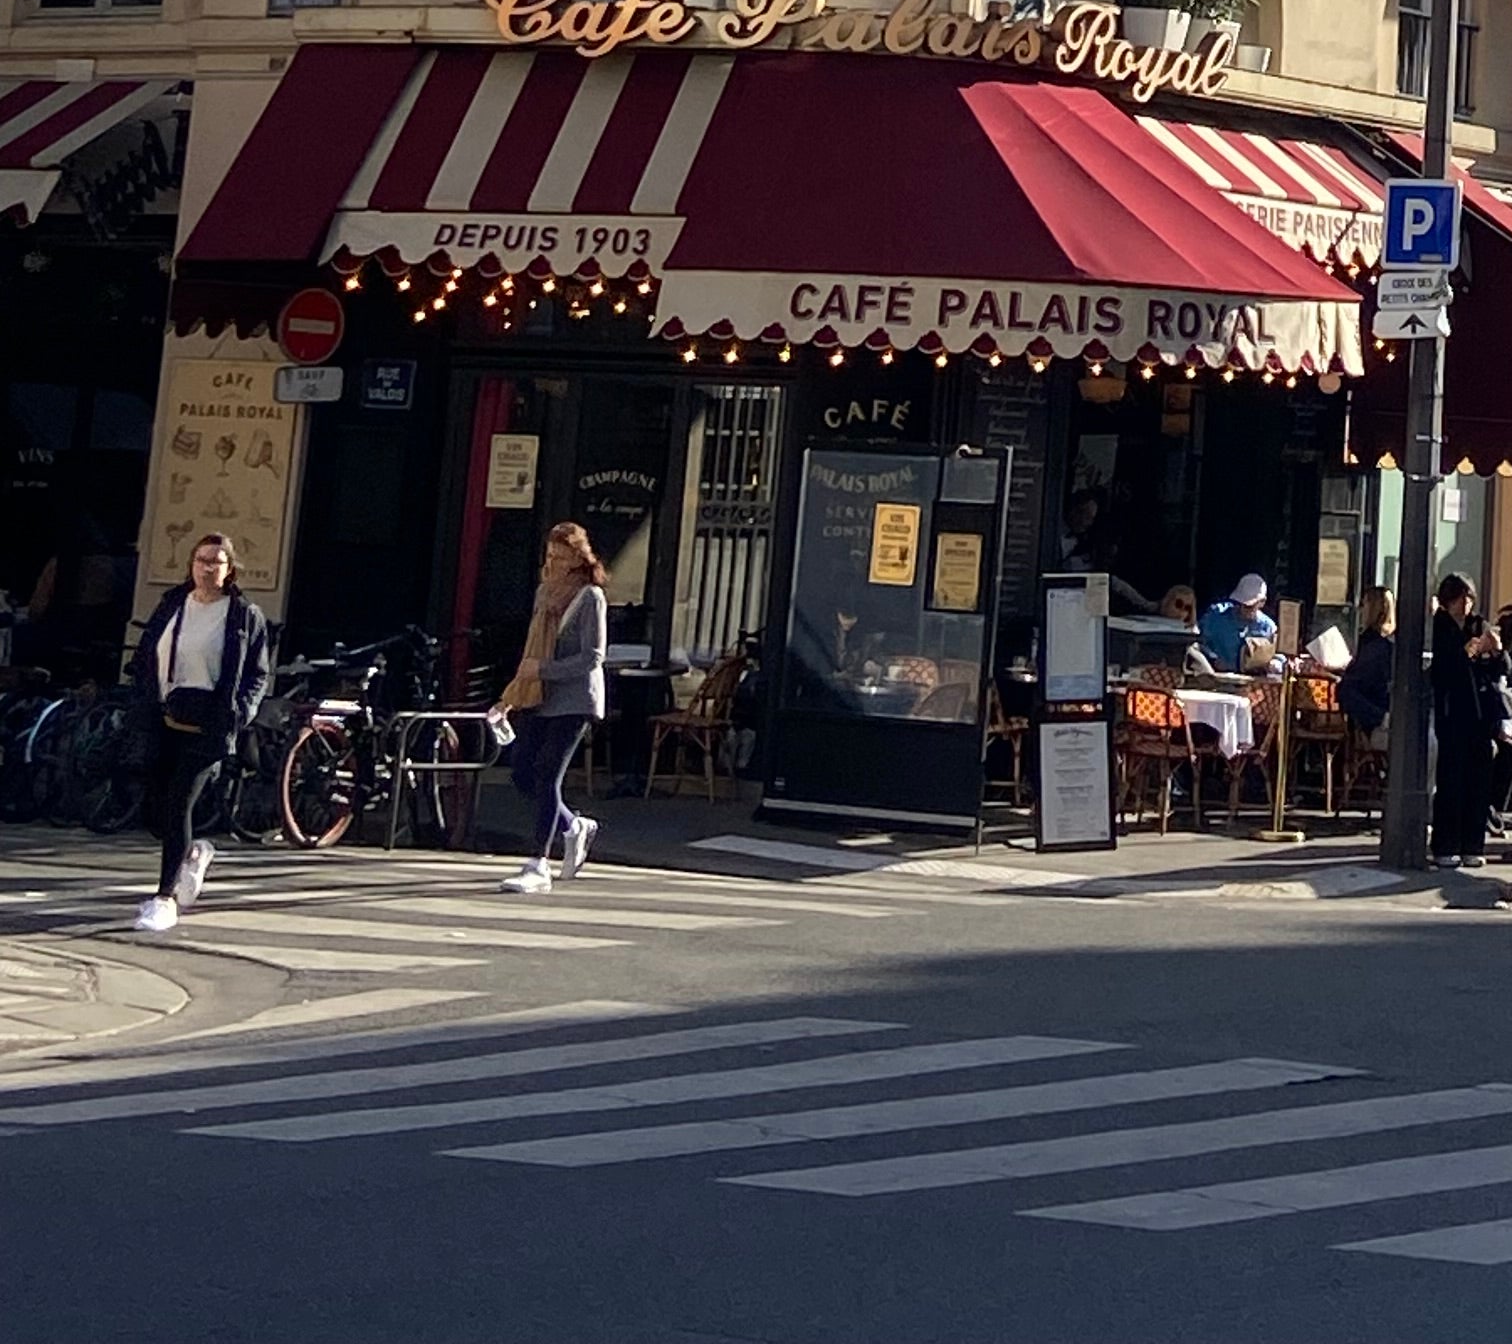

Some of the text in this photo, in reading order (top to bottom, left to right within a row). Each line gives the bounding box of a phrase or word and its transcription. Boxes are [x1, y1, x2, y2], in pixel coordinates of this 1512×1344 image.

[1055, 0, 1237, 103] Royal
[433, 223, 651, 256] DEPUIS 1903
[1402, 197, 1435, 251] P
[789, 281, 1277, 345] CAFÉ PALAIS ROYAL
[179, 403, 283, 421] PALAIS ROYAL
[823, 398, 912, 431] CAFÉ
